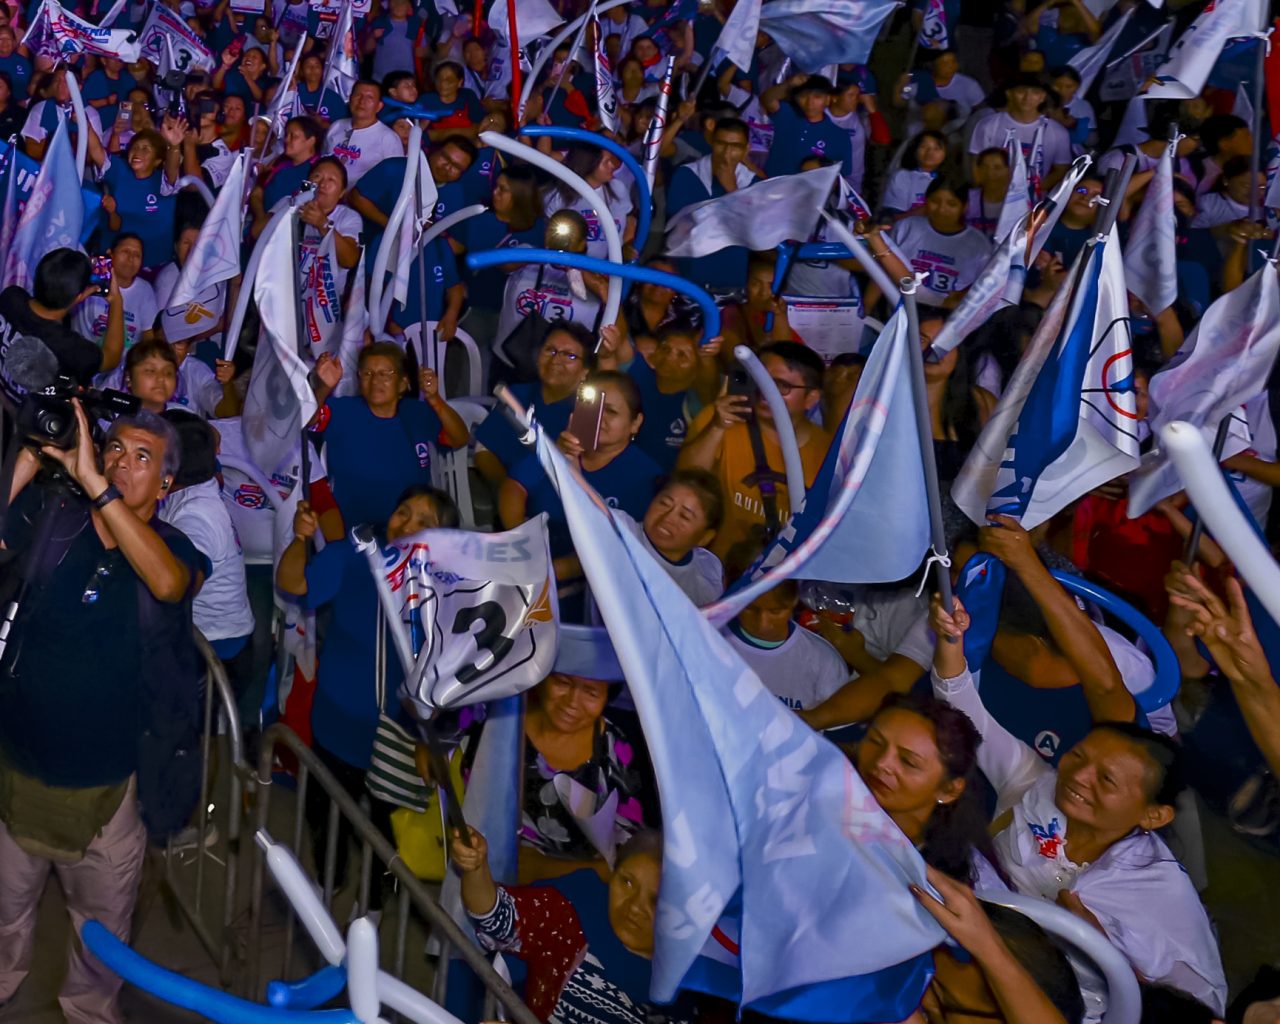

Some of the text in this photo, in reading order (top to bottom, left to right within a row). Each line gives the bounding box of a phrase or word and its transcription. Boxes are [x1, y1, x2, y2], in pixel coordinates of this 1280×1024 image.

[176, 48, 193, 70] 3
[935, 274, 949, 289] 3
[451, 600, 515, 685] 3
